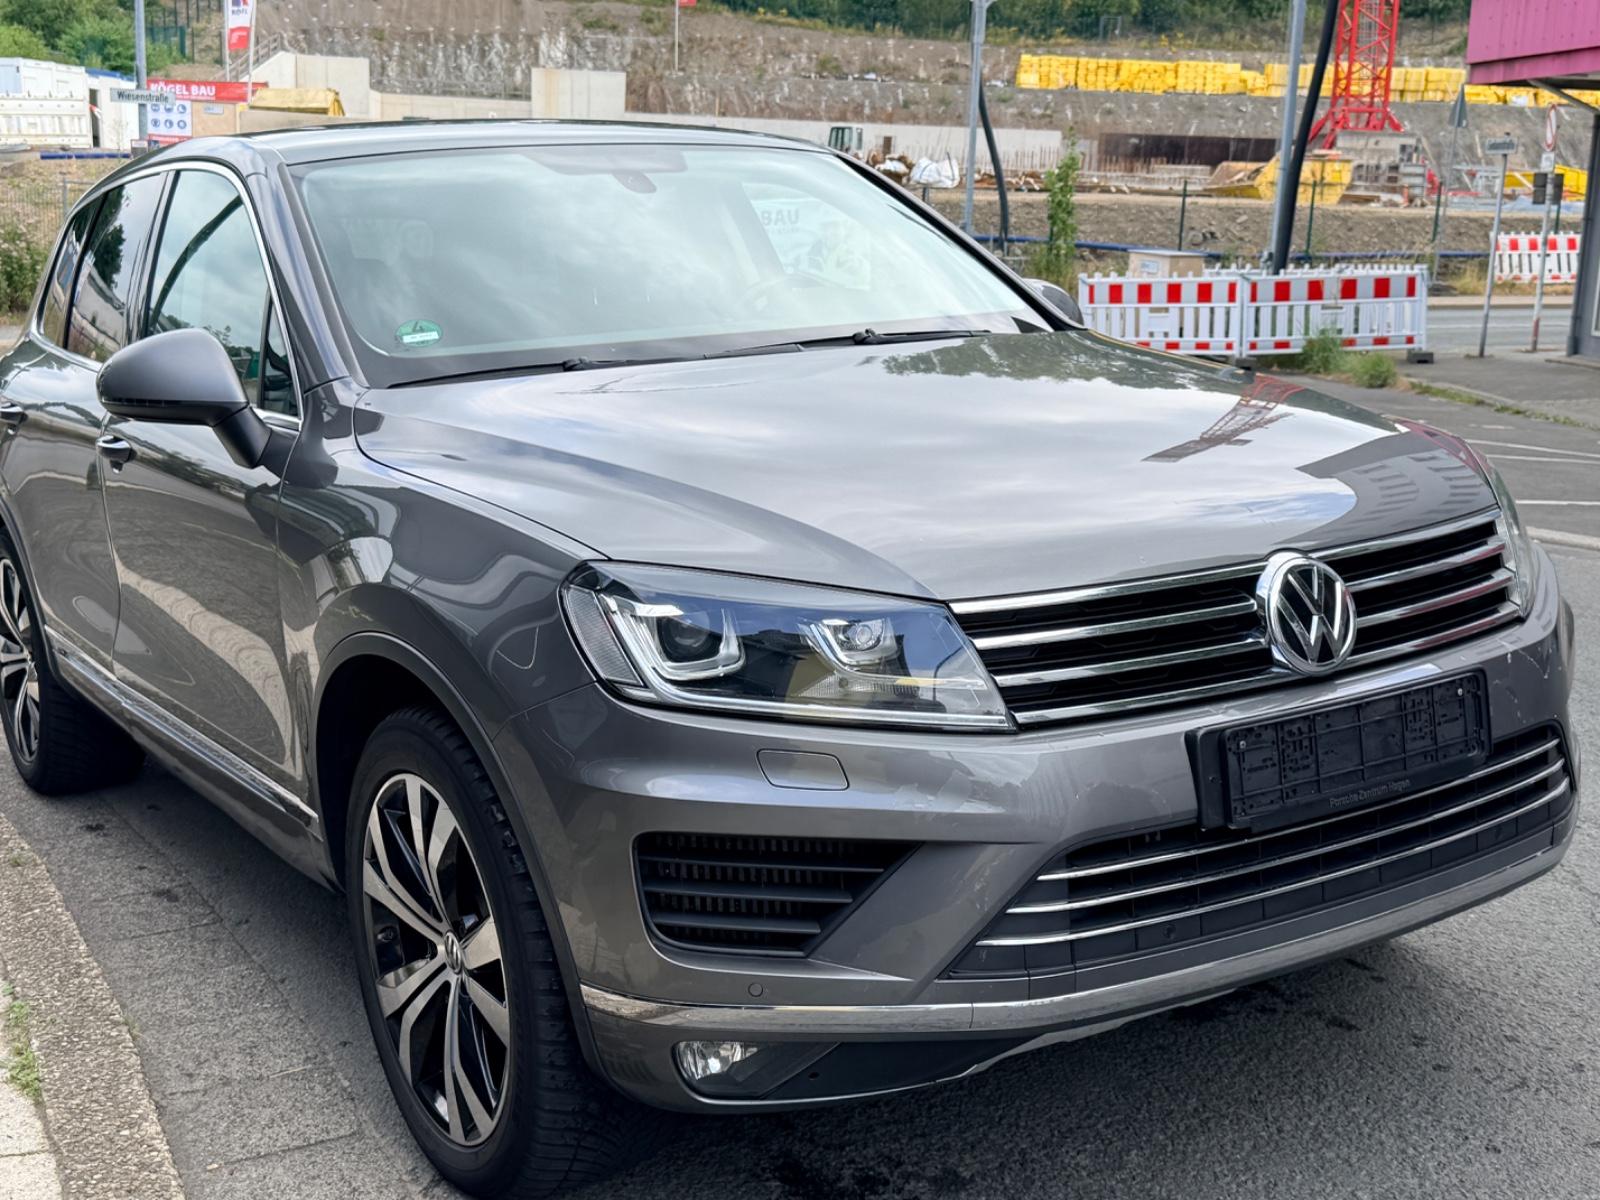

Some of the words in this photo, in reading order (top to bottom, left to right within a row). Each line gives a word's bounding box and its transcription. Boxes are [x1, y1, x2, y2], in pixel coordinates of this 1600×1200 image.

[191, 85, 216, 96] BAU
[117, 91, 169, 103] Wiesenstraße
[761, 208, 799, 226] BAU
